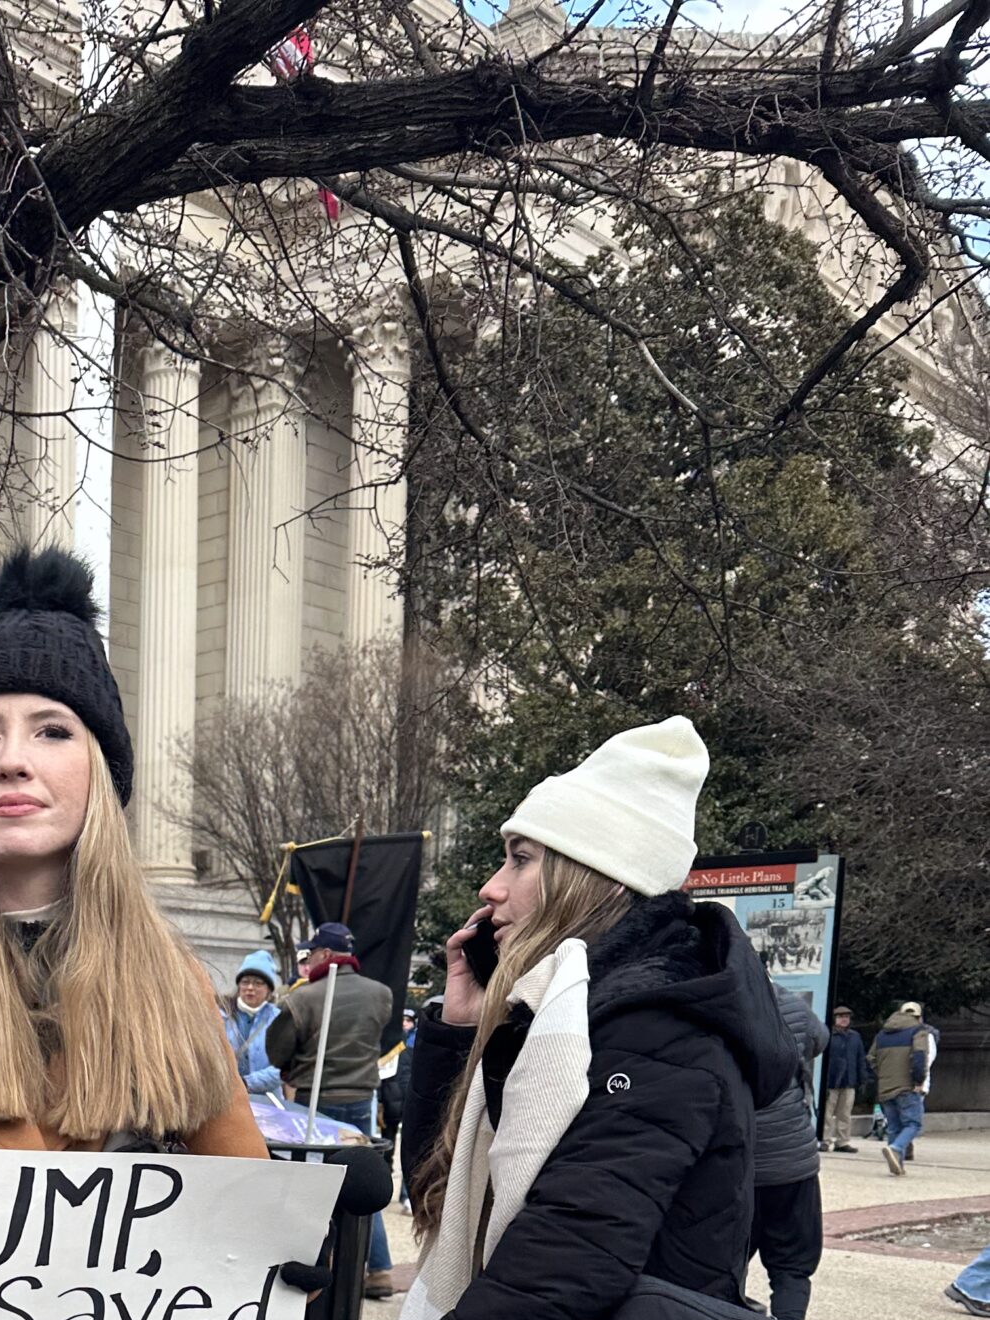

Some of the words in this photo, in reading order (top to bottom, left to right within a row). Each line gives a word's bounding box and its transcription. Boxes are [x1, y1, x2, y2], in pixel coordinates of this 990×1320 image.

[701, 873, 718, 885] No
[720, 871, 750, 884] Little
[752, 870, 782, 882] Plans
[717, 887, 744, 895] TRIANGLE
[744, 885, 771, 893] HERITAGE
[771, 884, 788, 892] TRAIL
[772, 898, 785, 909] 15
